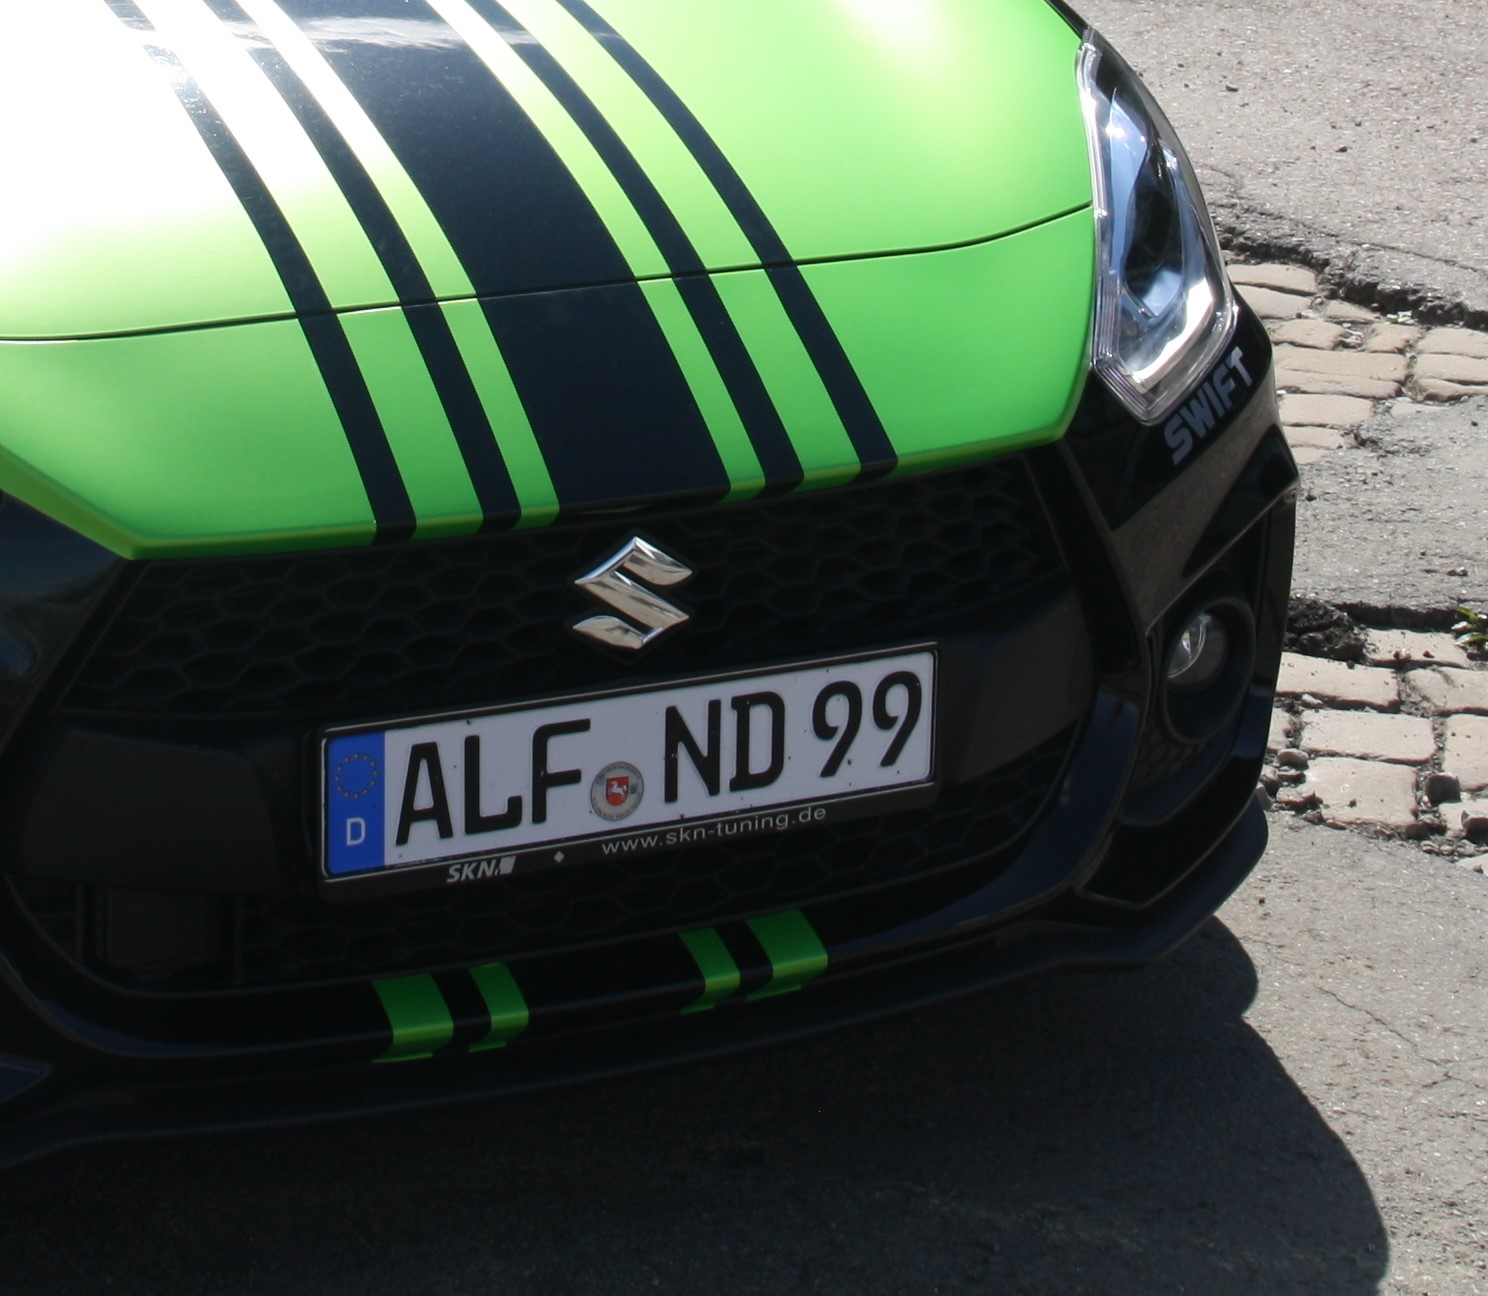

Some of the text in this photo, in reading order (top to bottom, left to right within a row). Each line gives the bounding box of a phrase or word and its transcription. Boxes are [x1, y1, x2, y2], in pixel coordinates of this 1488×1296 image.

[1164, 345, 1253, 465] SWIFT
[395, 717, 591, 846] ALF
[663, 690, 786, 804] ND
[812, 670, 923, 779] 99
[345, 816, 366, 846] D
[601, 805, 827, 855] www.skn-tuning.de
